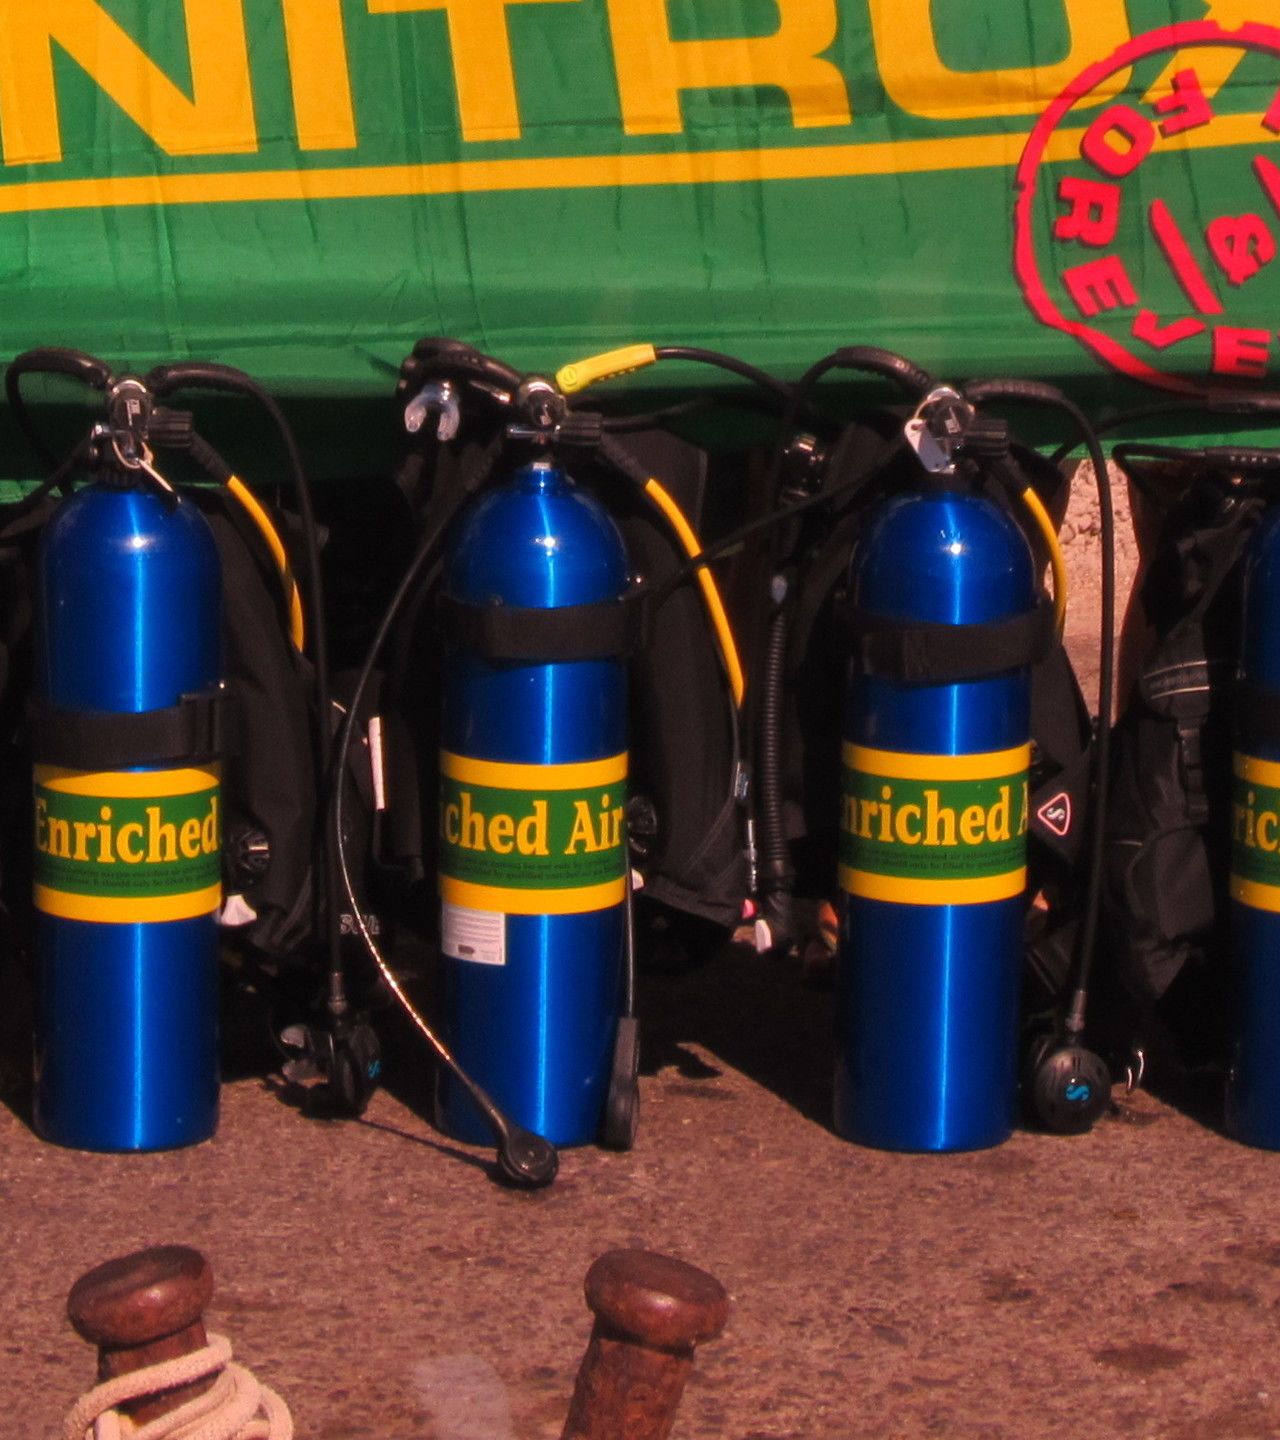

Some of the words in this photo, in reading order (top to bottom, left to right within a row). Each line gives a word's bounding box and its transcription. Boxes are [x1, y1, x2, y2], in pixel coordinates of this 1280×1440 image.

[34, 795, 218, 864] Enriched
[441, 791, 550, 856] ched
[564, 793, 624, 855] Air
